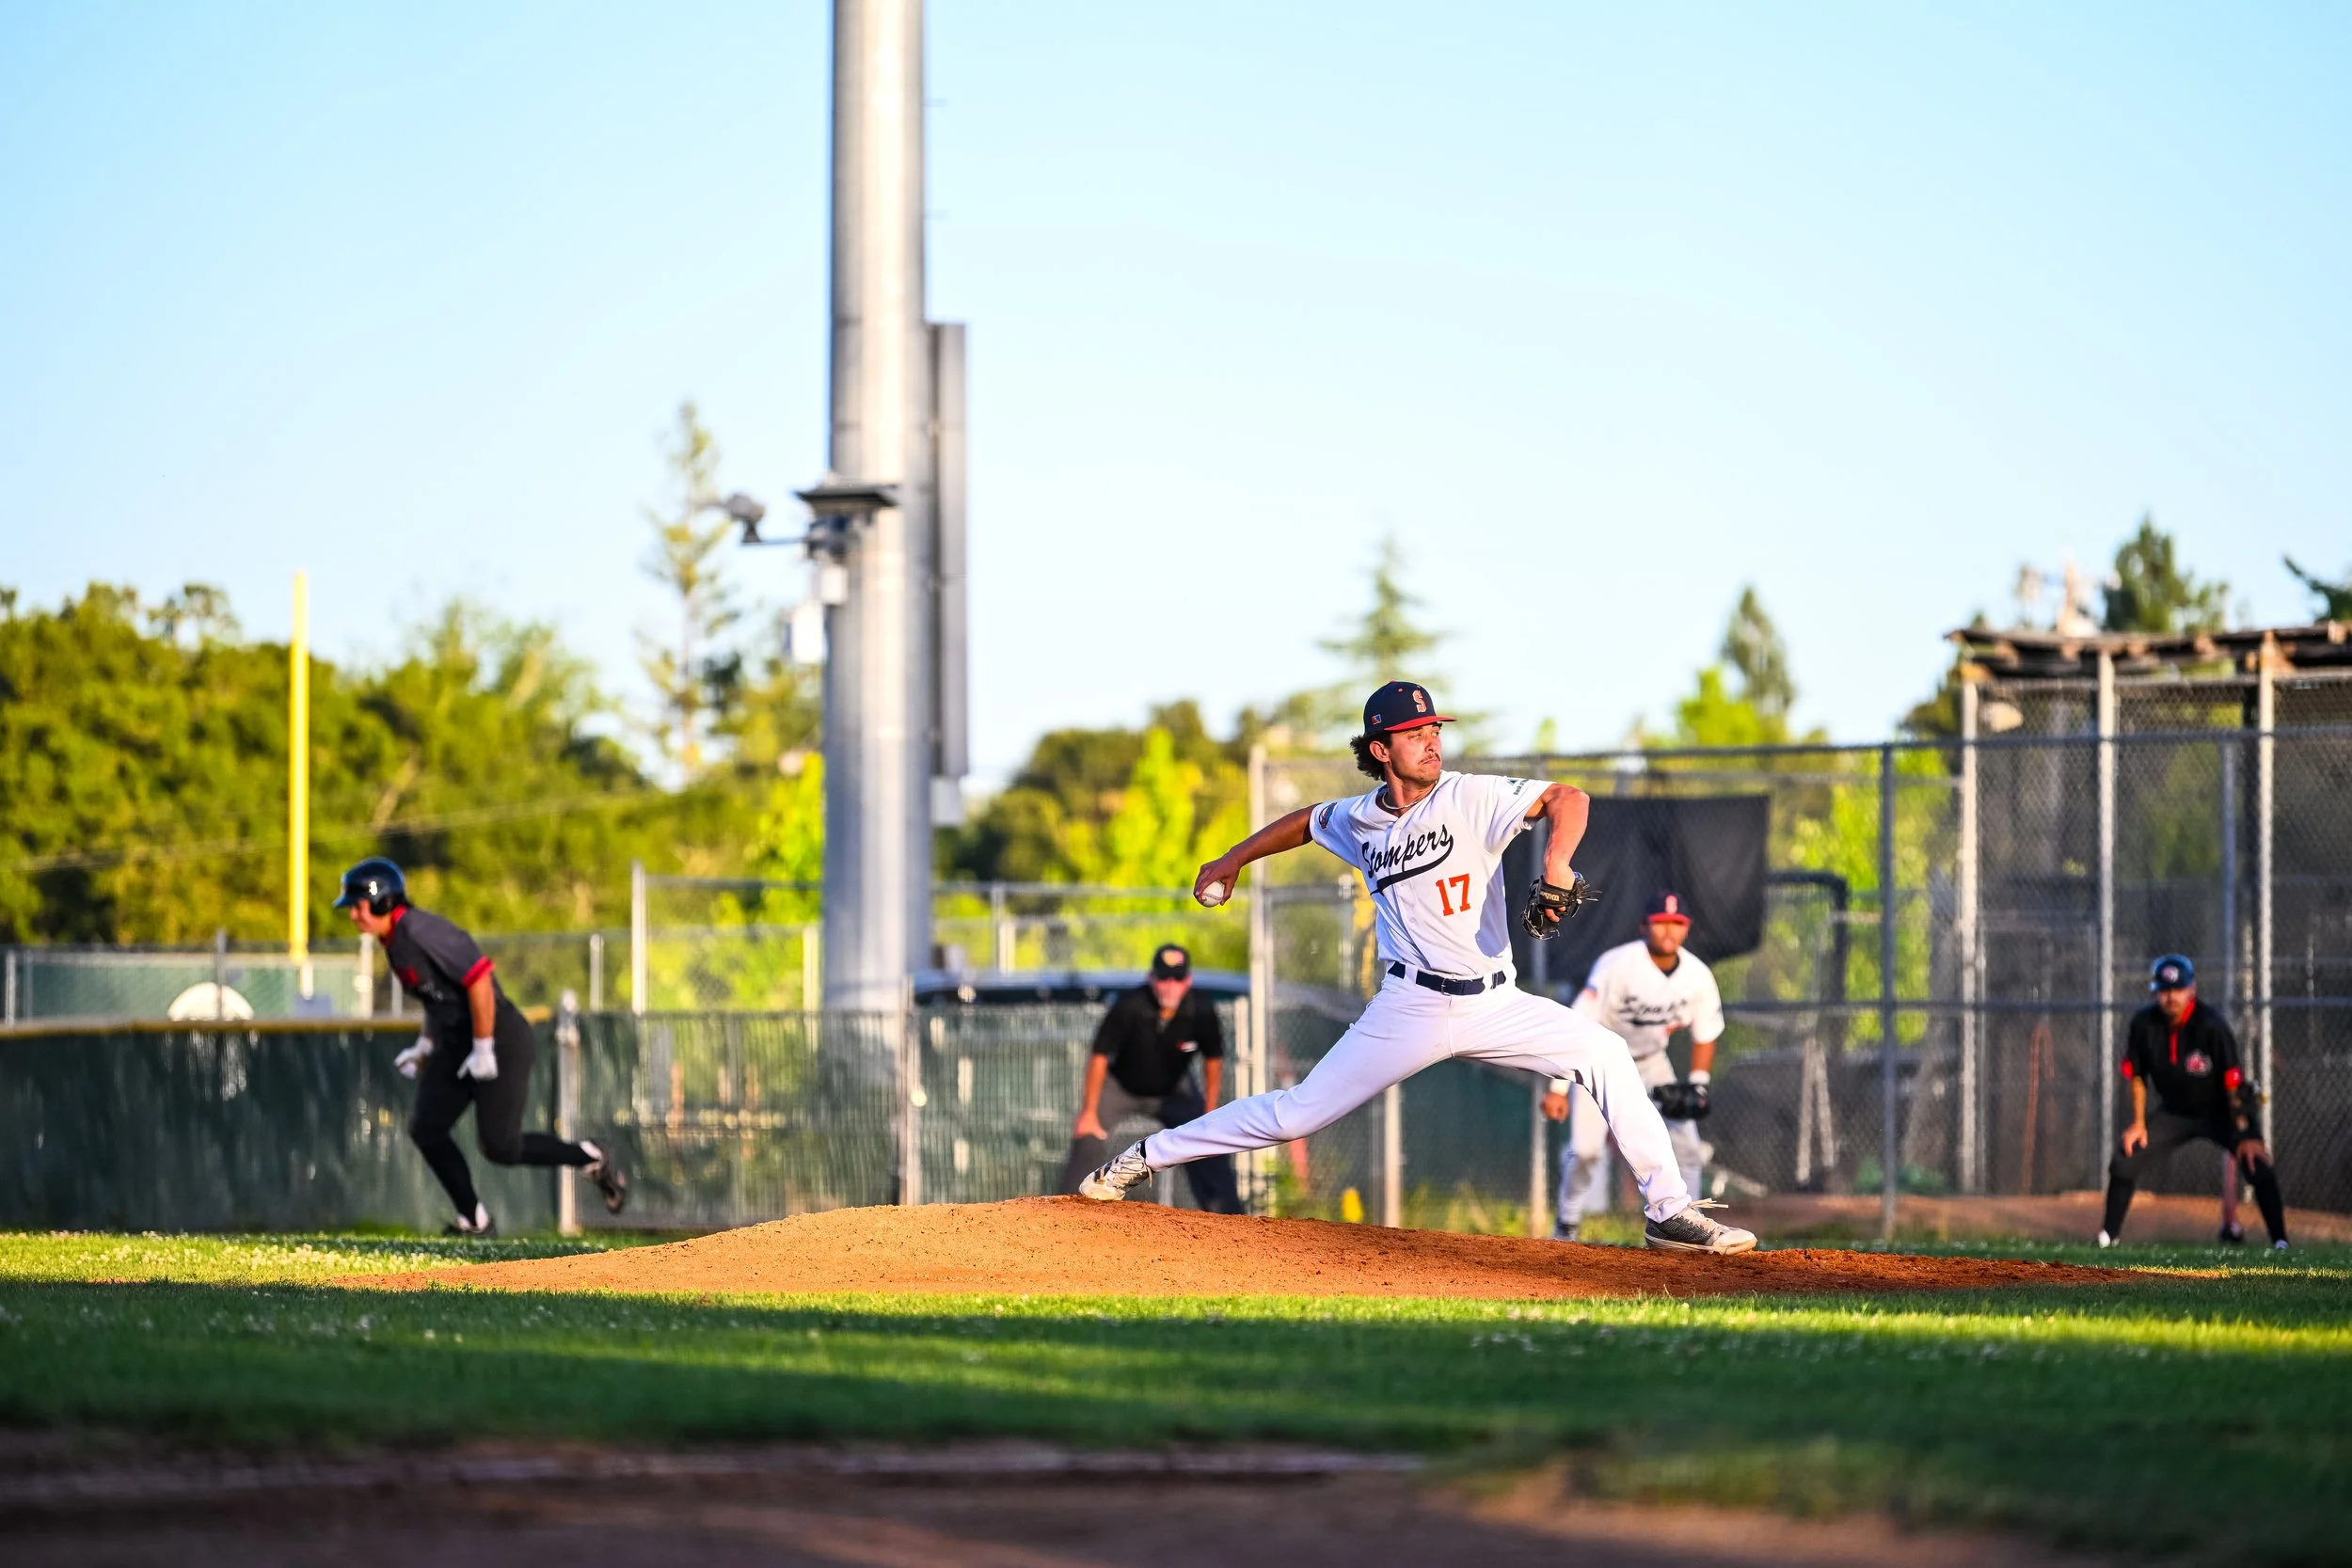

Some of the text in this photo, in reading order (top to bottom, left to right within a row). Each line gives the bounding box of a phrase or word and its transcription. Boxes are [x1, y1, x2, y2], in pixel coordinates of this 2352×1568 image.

[1412, 689, 1427, 713] S
[1362, 824, 1454, 879] Stompers
[1436, 873, 1471, 916] 17
